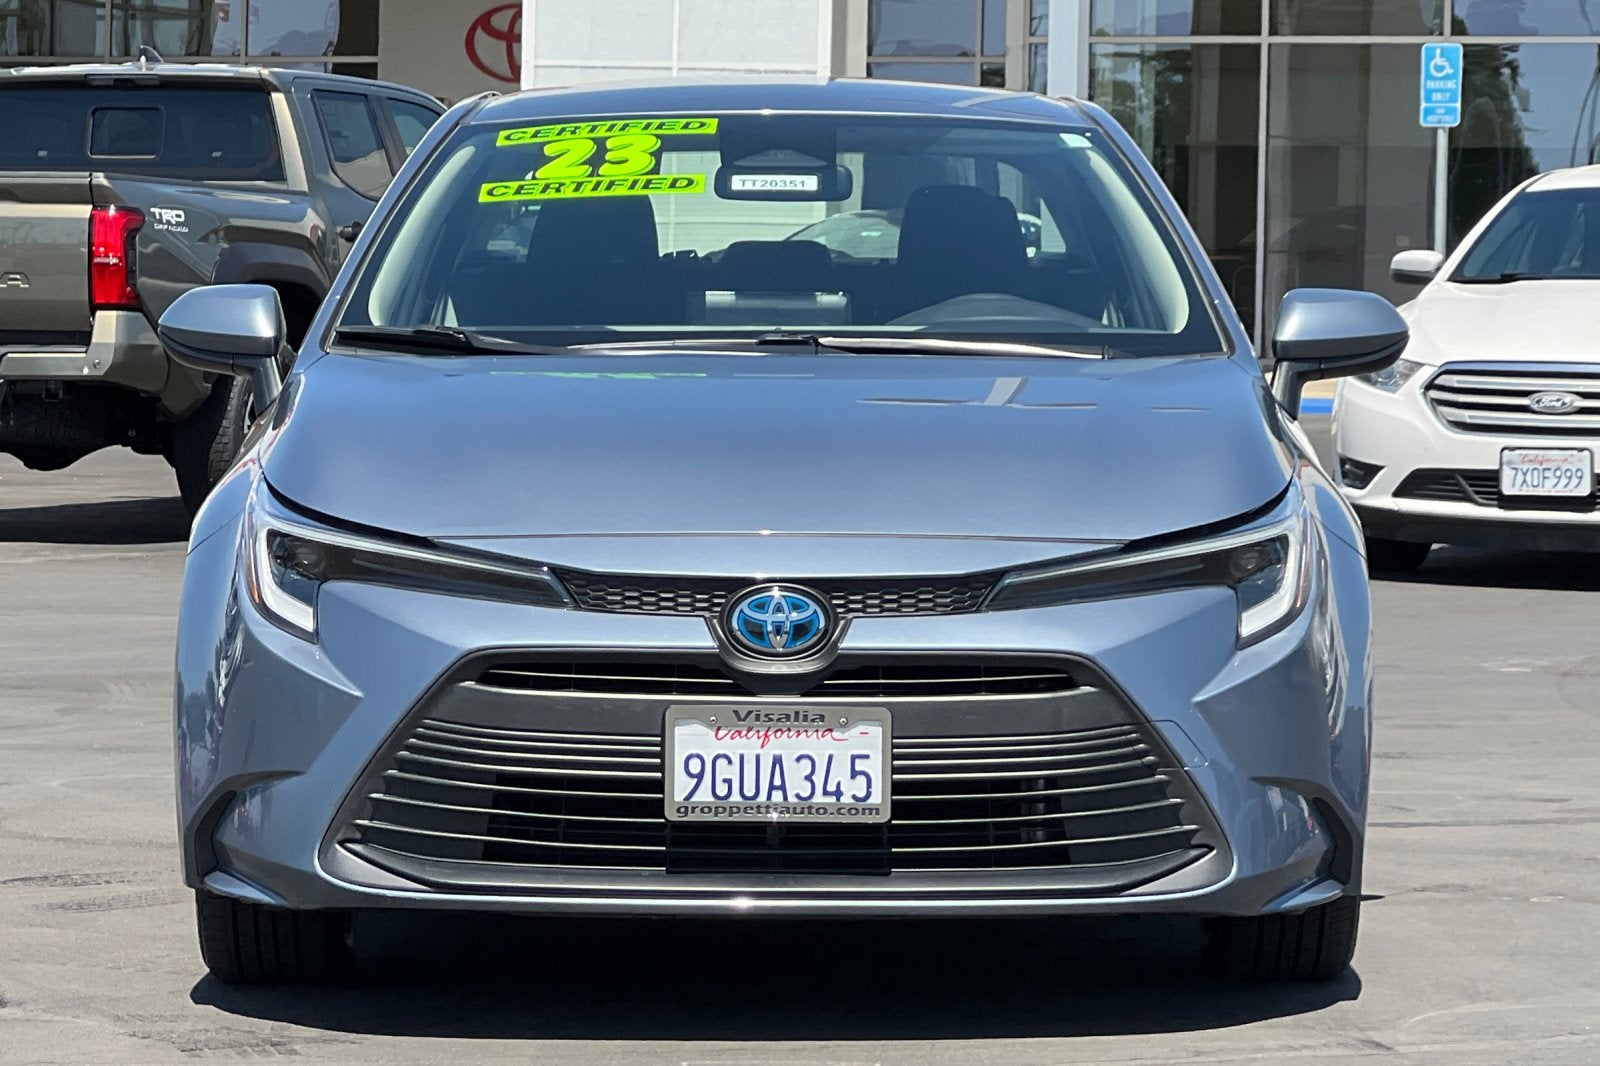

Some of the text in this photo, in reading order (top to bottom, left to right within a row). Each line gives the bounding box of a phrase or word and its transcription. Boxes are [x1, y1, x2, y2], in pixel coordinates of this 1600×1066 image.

[503, 119, 710, 142] CERTIFIED
[535, 134, 662, 180] 23
[485, 176, 698, 198] CERTIFIED
[738, 178, 806, 189] TT20351
[150, 207, 185, 225] TRD
[732, 709, 826, 724] Visalia
[714, 726, 849, 749] California
[682, 752, 873, 802] 9GUA345
[675, 803, 881, 819] groppettiauto.com
